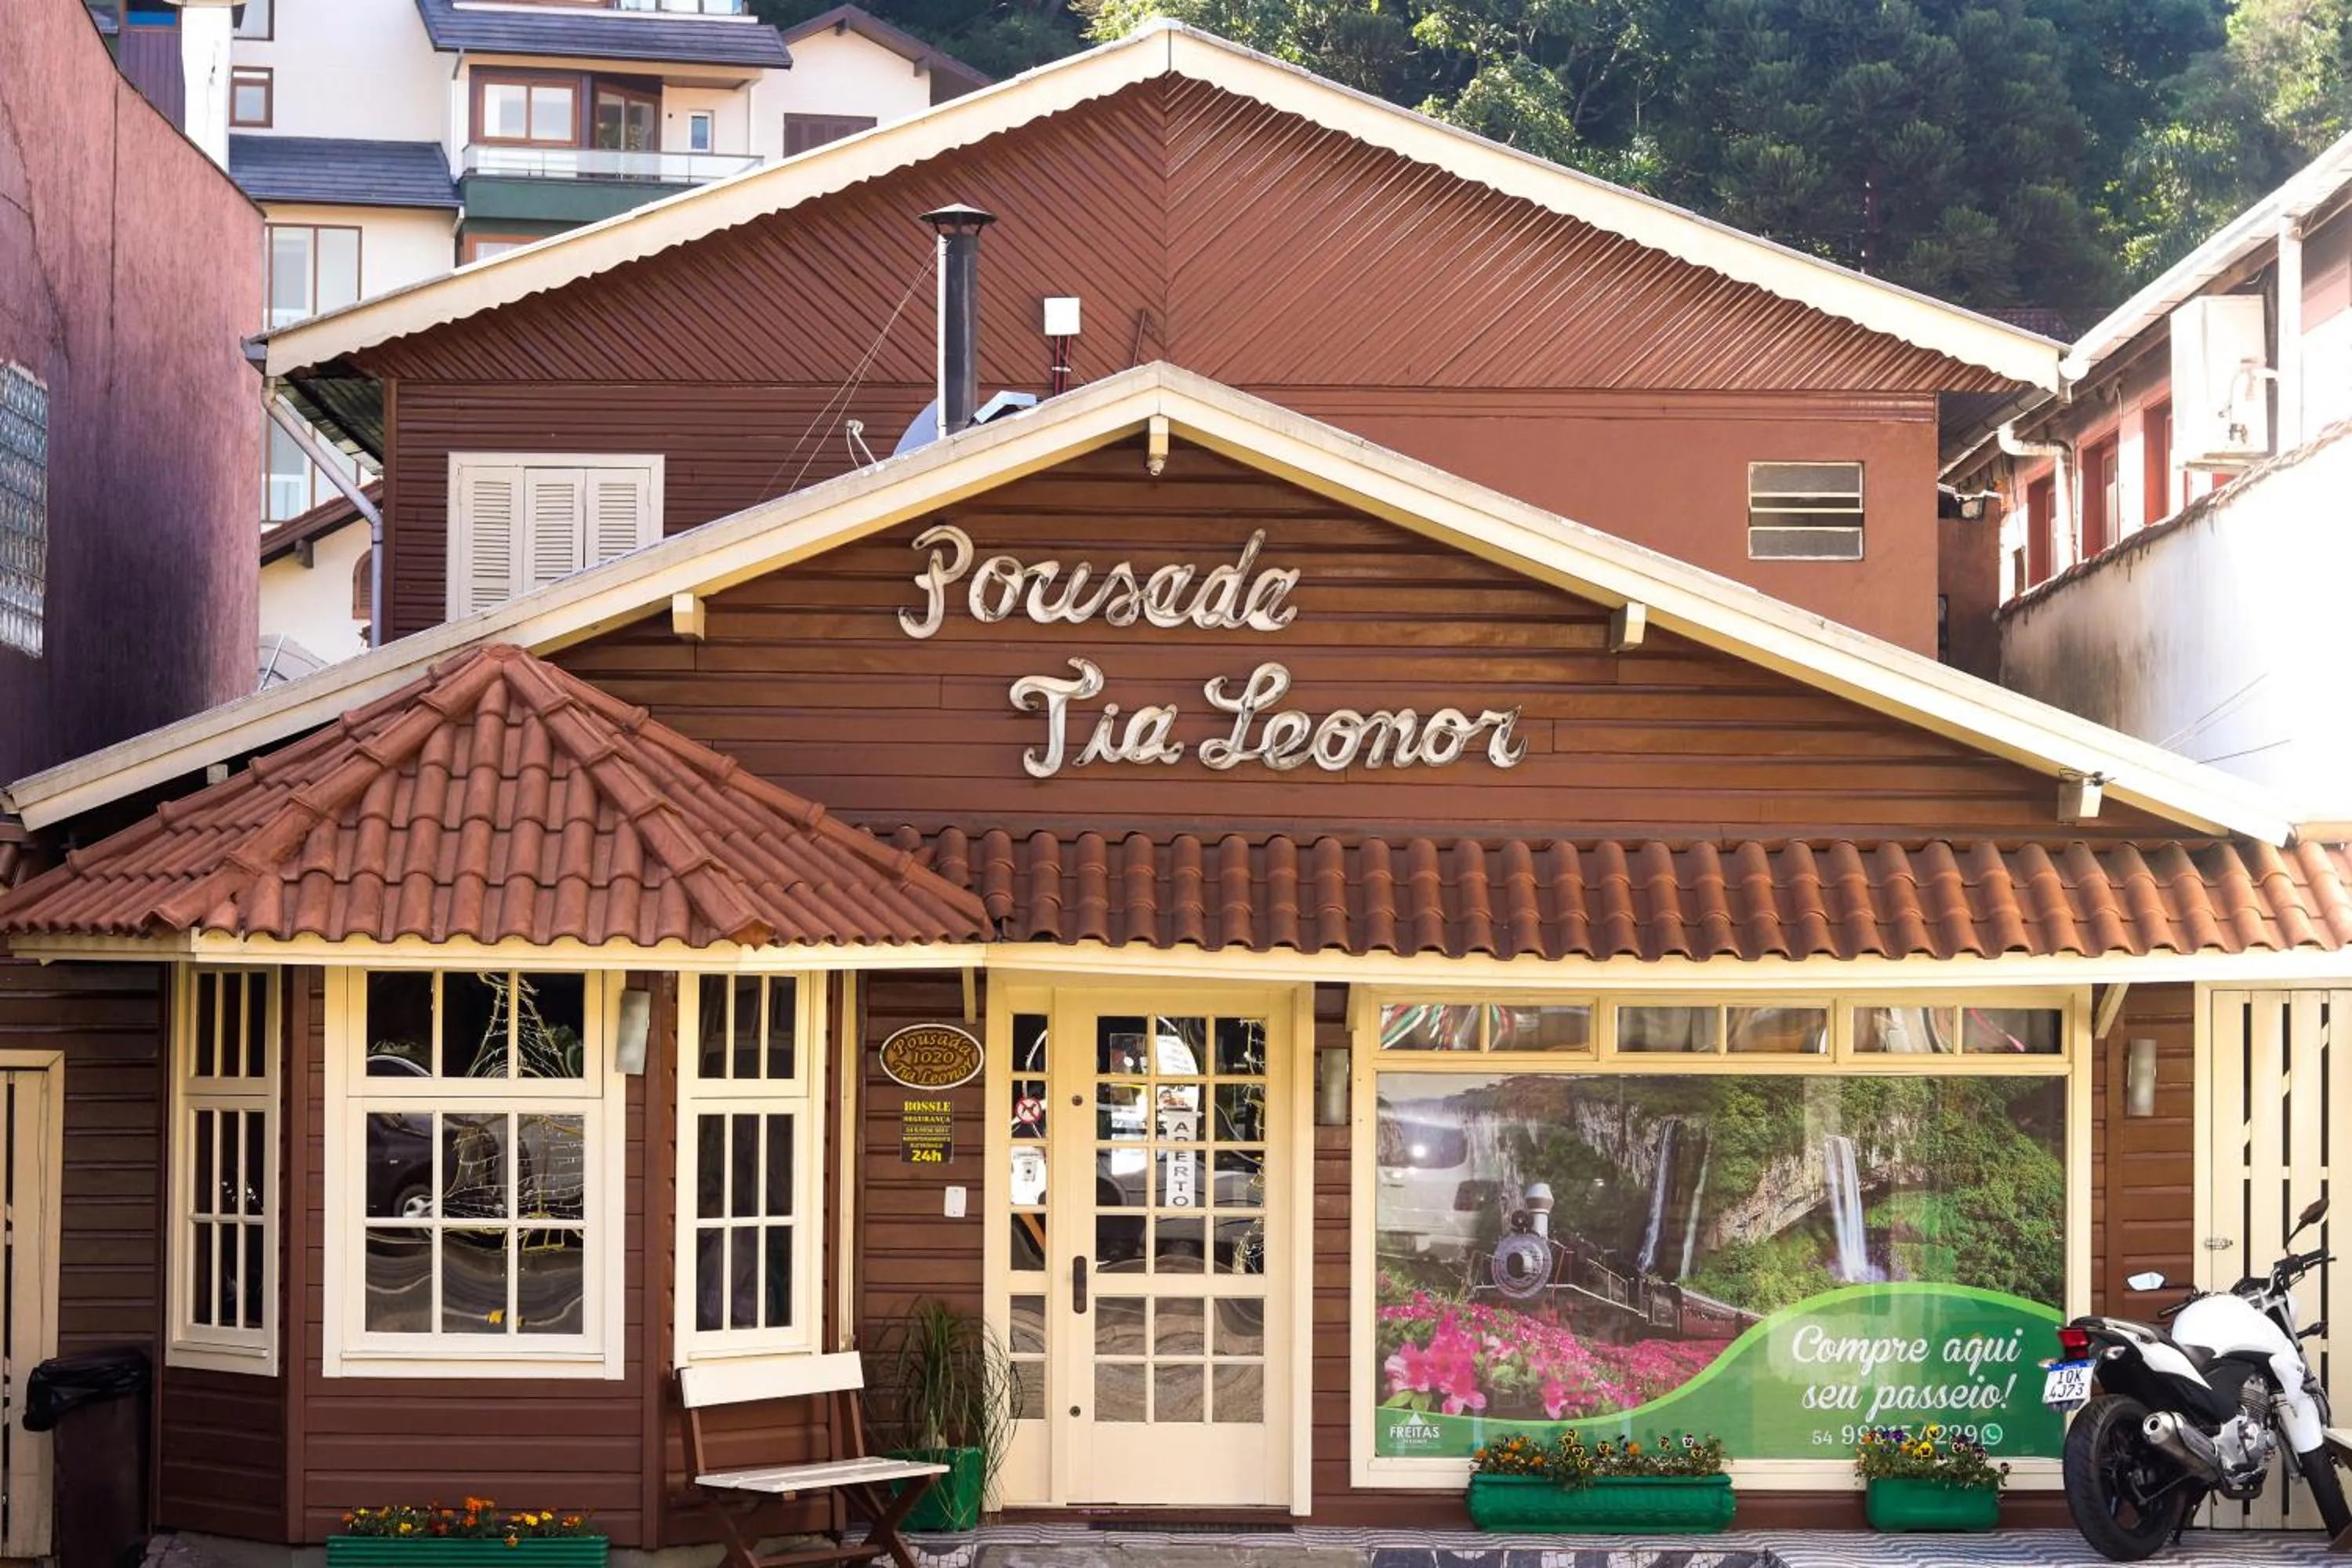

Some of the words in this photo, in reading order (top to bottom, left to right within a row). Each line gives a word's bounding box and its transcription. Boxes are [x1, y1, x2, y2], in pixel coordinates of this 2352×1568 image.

[898, 524, 1301, 639] Pousada
[1009, 656, 1185, 778] Tia
[1198, 662, 1529, 771] Leonor
[893, 1033, 973, 1055] Pousada
[913, 1051, 955, 1064] 1020
[894, 1061, 916, 1082] Tia
[918, 1058, 973, 1083] Leonor
[911, 1149, 942, 1162] 24h
[1791, 1325, 1930, 1377] Compre
[1942, 1328, 2024, 1377] aqui
[1802, 1382, 1861, 1410] seu
[1865, 1374, 2018, 1422] passeio!
[1390, 1426, 1440, 1439] FREITAS
[1812, 1429, 1833, 1446] 54
